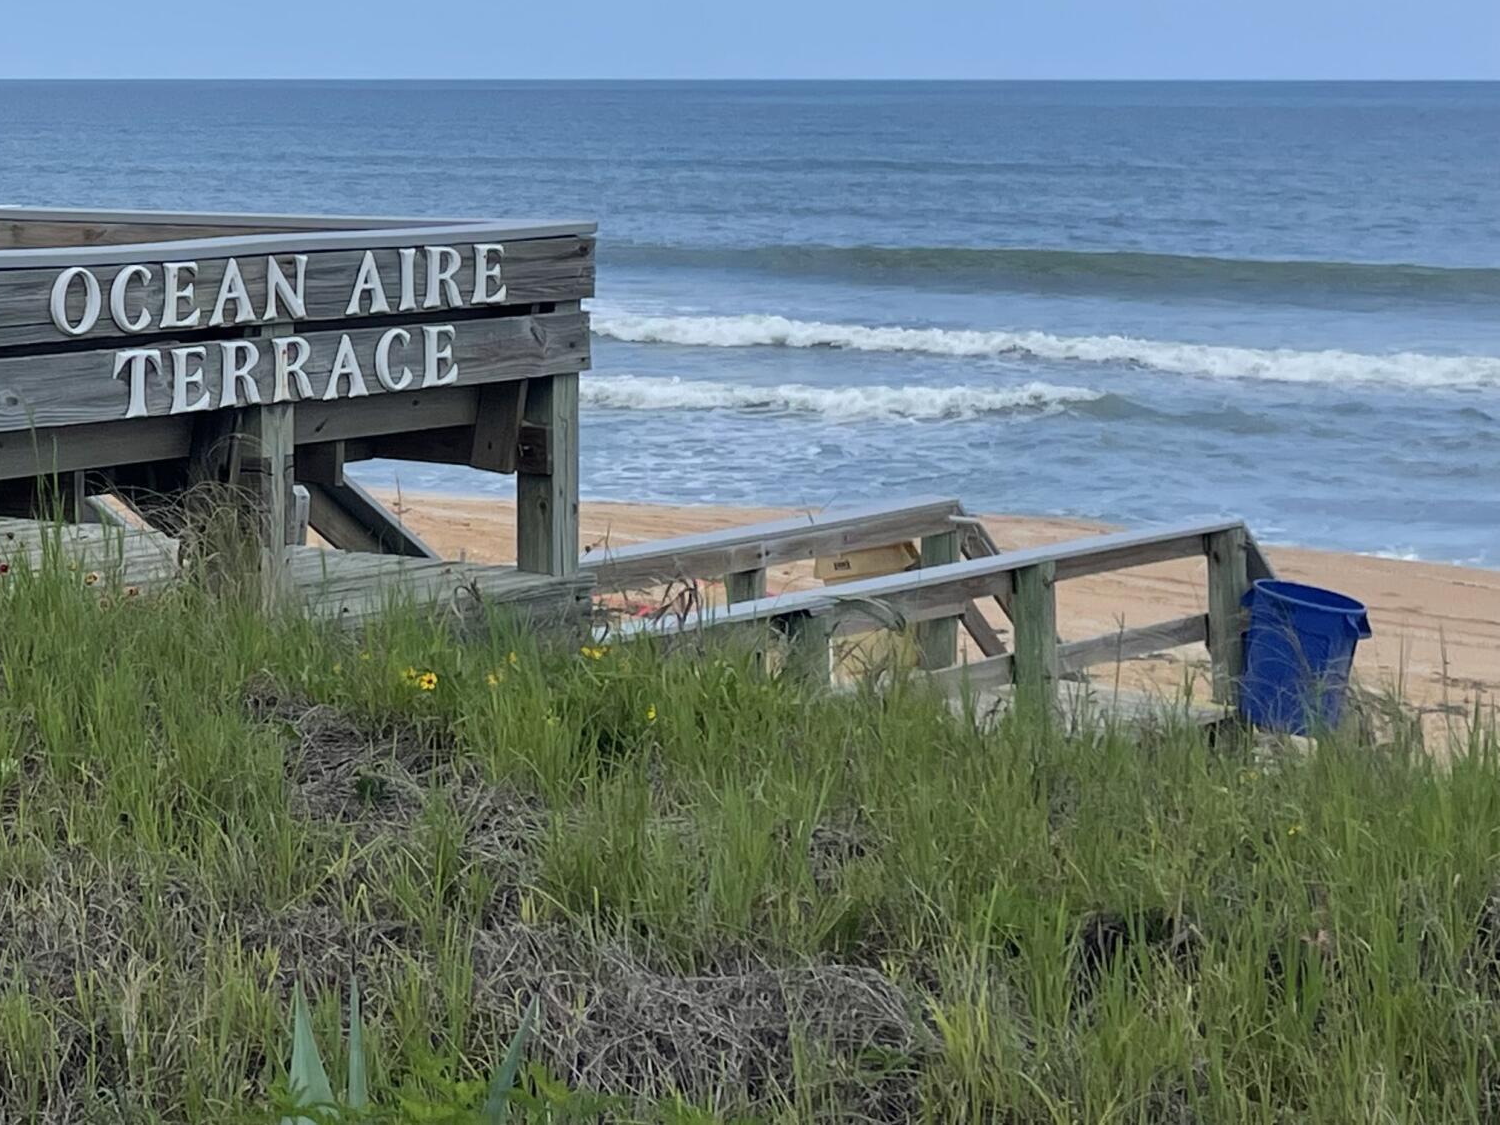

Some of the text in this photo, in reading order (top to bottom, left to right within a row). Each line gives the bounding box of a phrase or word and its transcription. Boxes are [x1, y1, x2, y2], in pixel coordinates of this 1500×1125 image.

[50, 243, 506, 335] OCEAN AIRE
[113, 324, 459, 418] TERRACE
